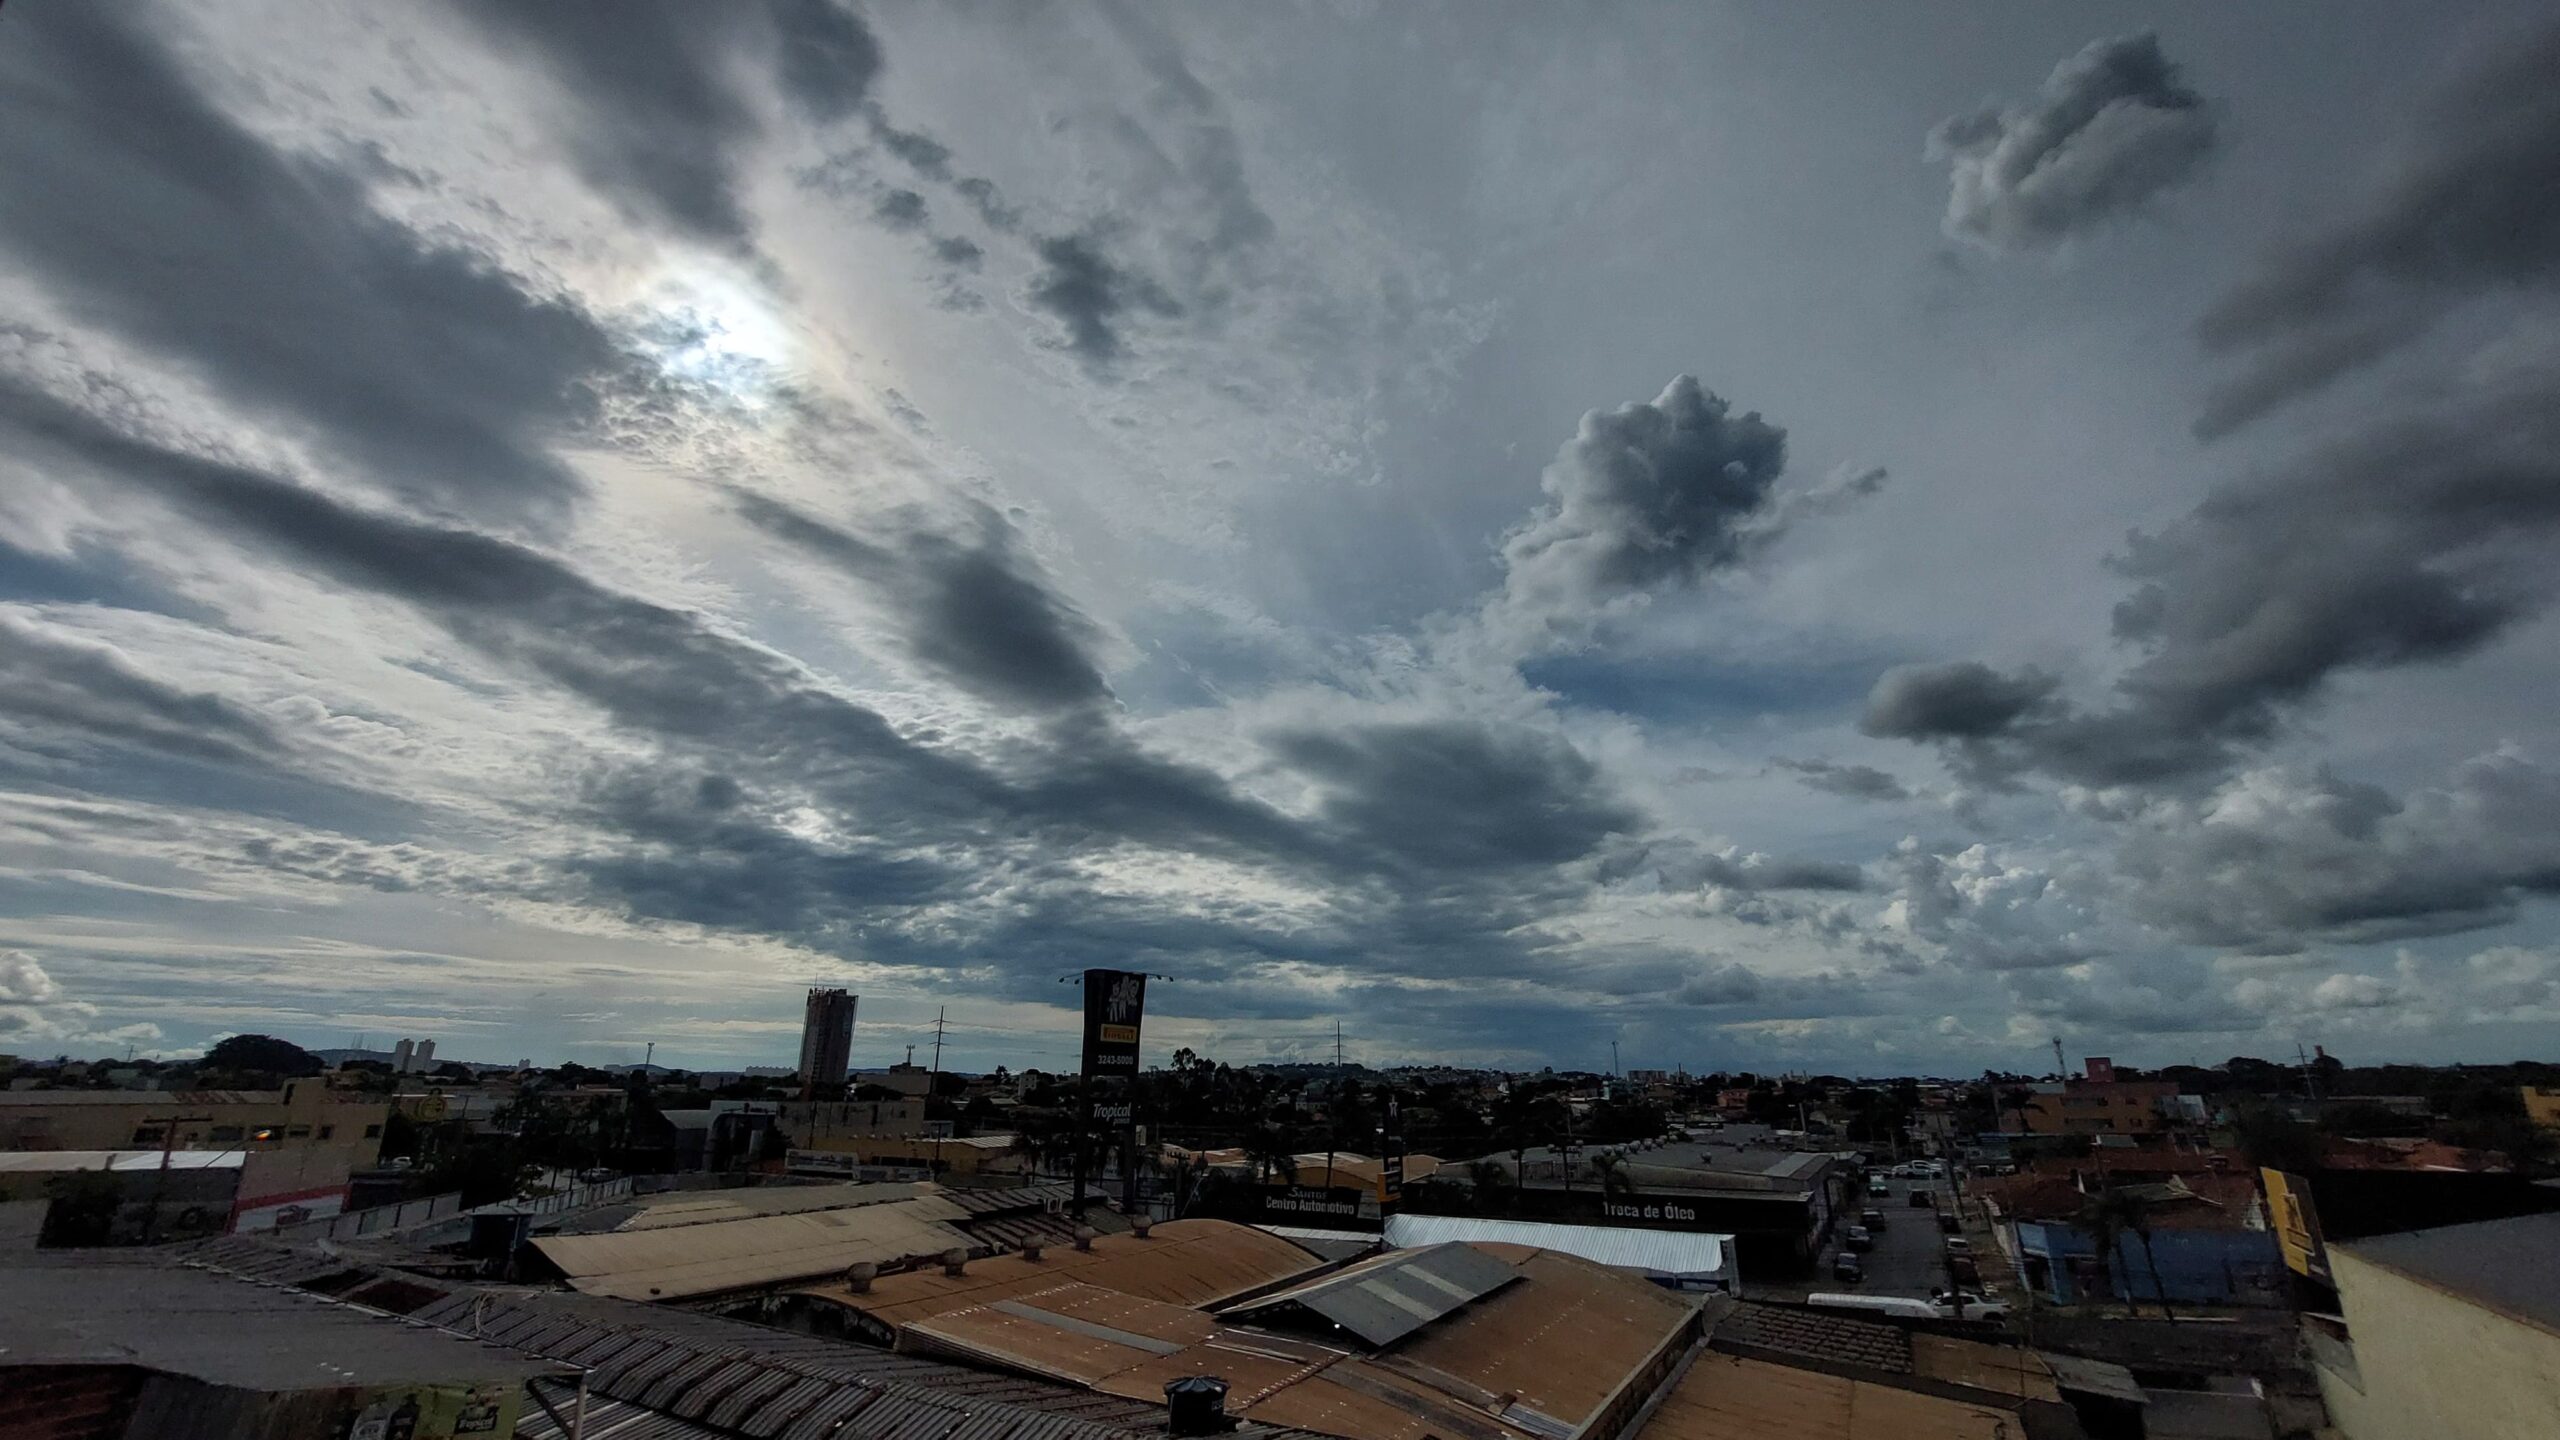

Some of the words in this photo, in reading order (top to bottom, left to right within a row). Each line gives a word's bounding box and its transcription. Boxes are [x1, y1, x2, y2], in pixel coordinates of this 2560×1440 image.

[1093, 1102, 1132, 1122] Tropical
[1266, 1195, 1297, 1211] Centro
[1299, 1200, 1355, 1215] Automotivo
[1602, 1201, 1639, 1218] Troca
[1643, 1204, 1660, 1218] de
[1664, 1202, 1696, 1220] Óleo
